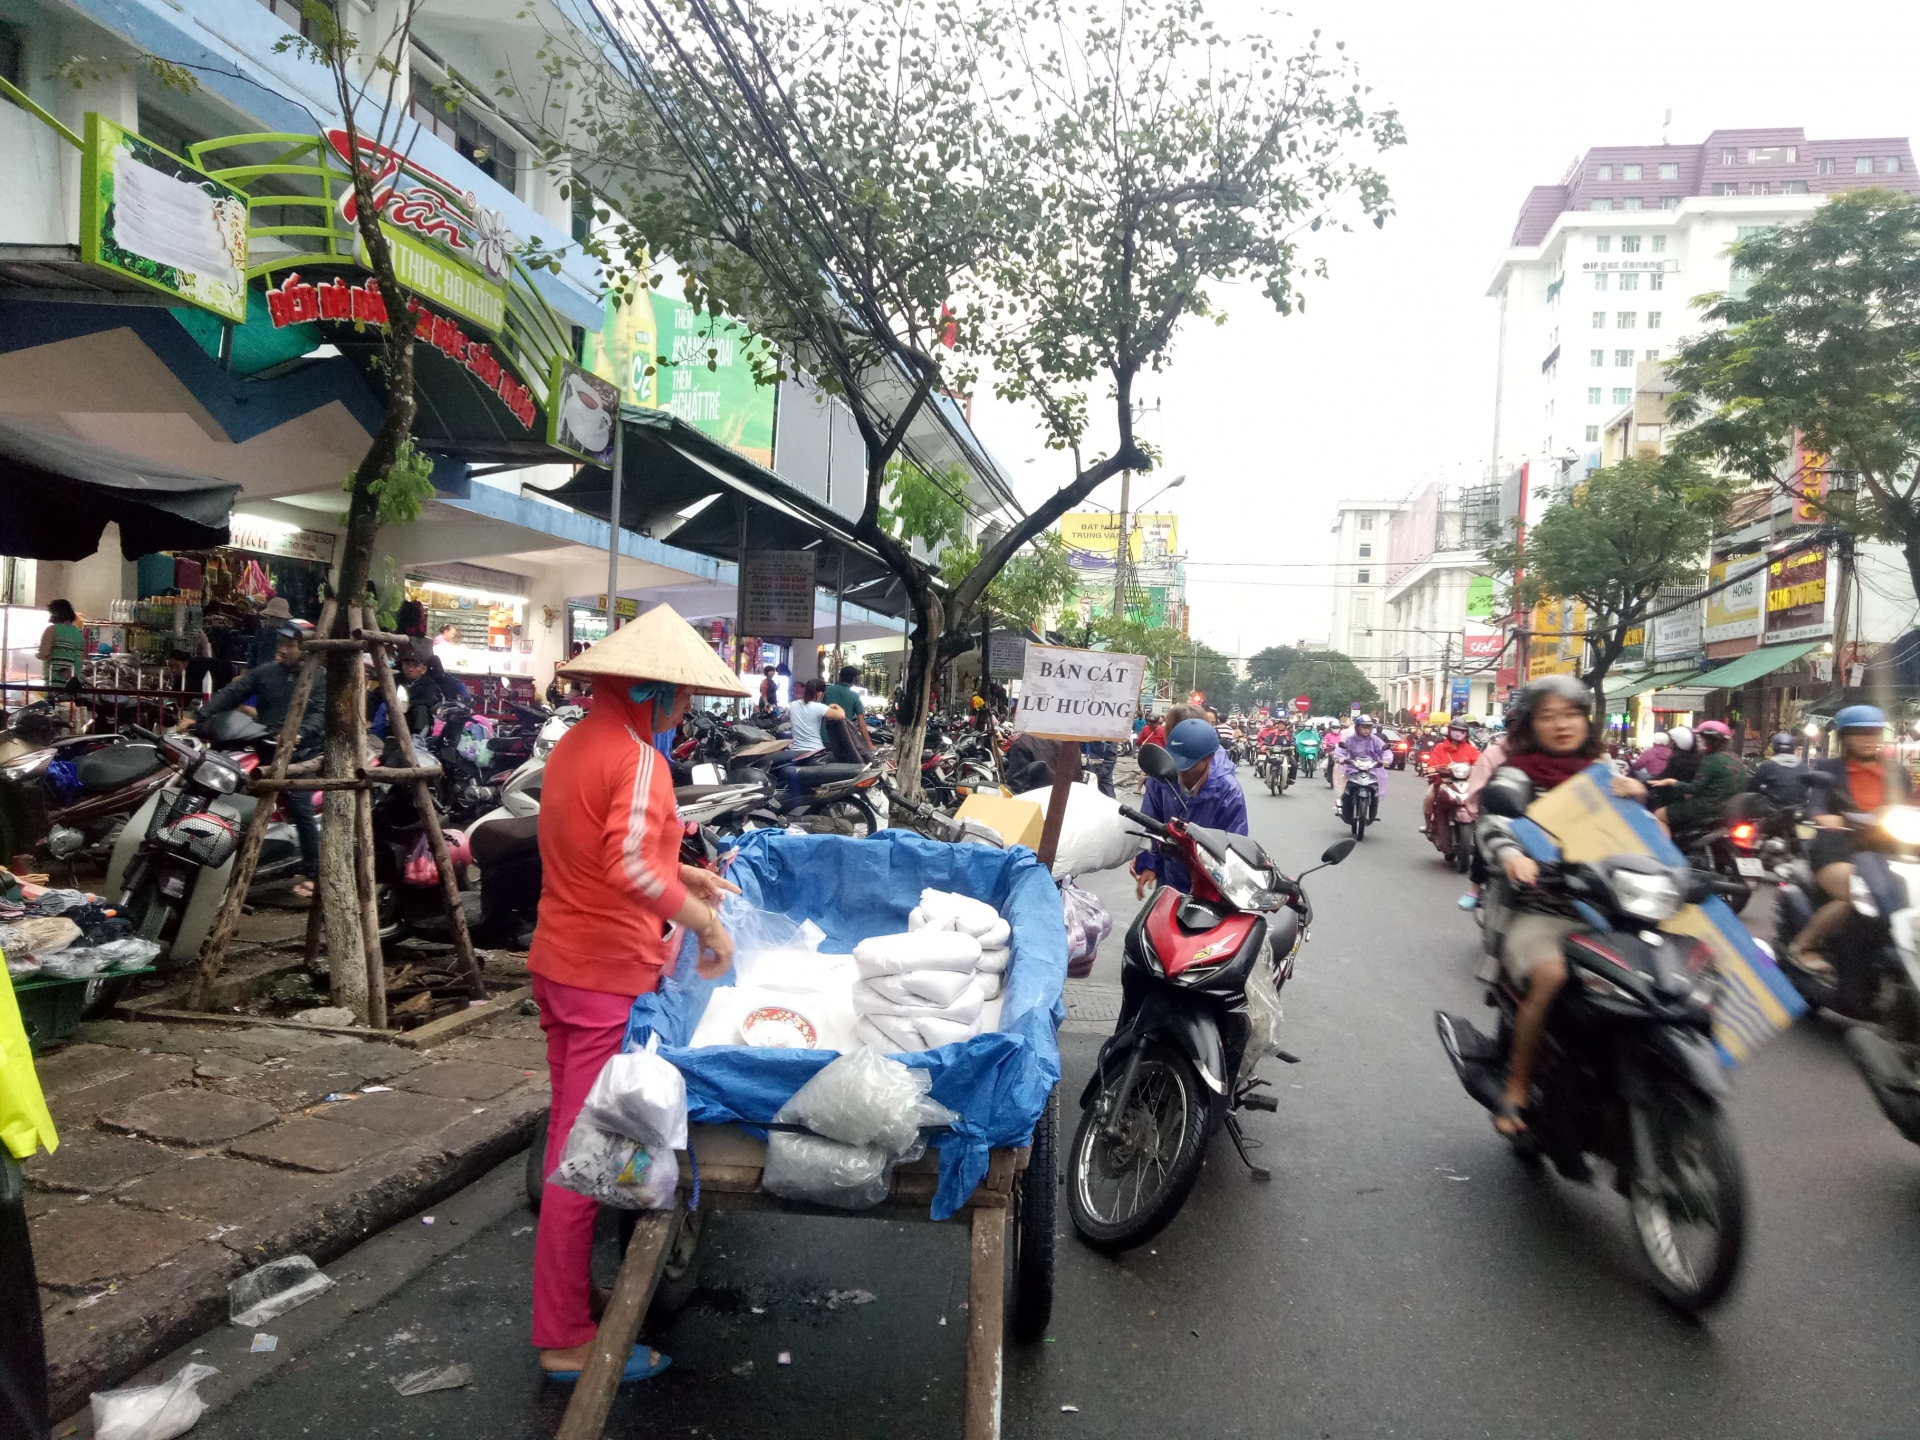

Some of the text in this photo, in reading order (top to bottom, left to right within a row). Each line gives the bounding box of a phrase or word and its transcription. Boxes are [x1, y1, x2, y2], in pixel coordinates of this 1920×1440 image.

[1582, 262, 1599, 270] elf
[1622, 260, 1663, 271] danang
[399, 245, 441, 294] THỰC
[443, 267, 463, 306] ĐÀ
[465, 279, 502, 328] NẴNG
[674, 306, 694, 330] THÊM
[671, 367, 692, 391] THÊM
[1039, 658, 1129, 683] BÁN CÁT
[1021, 695, 1131, 718] LƯ HƯƠNG
[1186, 903, 1214, 917] HONDA
